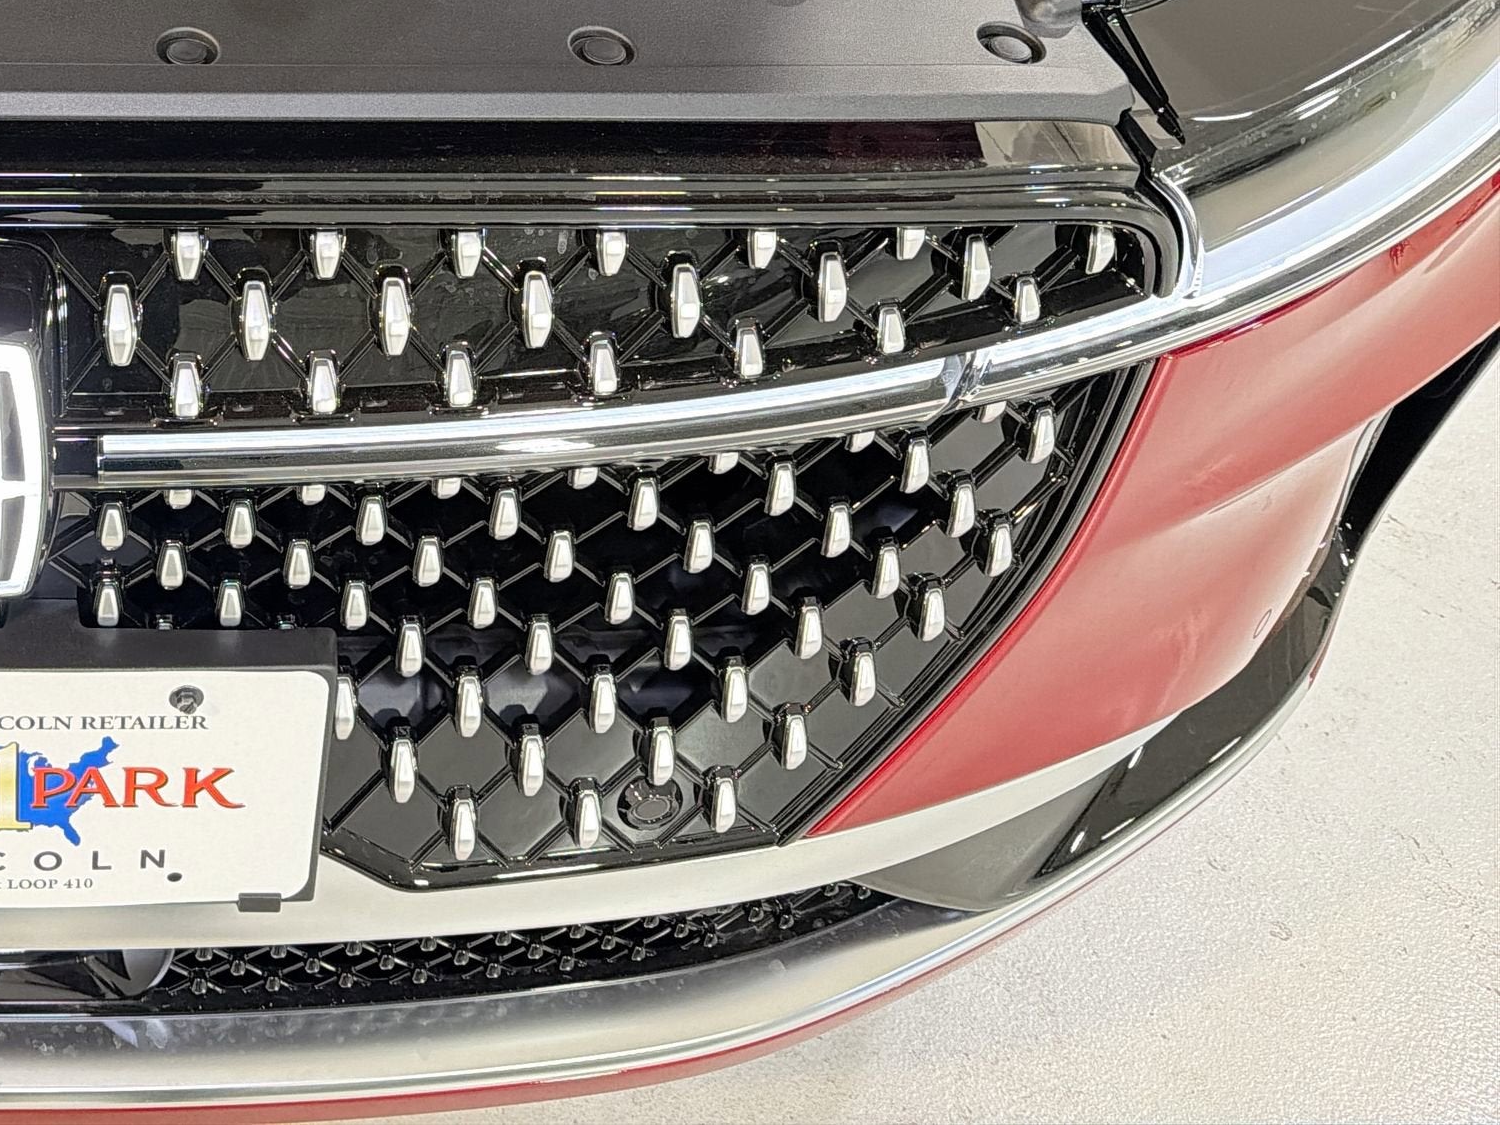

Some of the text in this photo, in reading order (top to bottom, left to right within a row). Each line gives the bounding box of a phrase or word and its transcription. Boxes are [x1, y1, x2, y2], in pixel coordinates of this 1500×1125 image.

[80, 714, 210, 730] RETAILER
[29, 765, 247, 809] PARK
[6, 877, 59, 890] LOOP
[63, 877, 94, 890] 410
